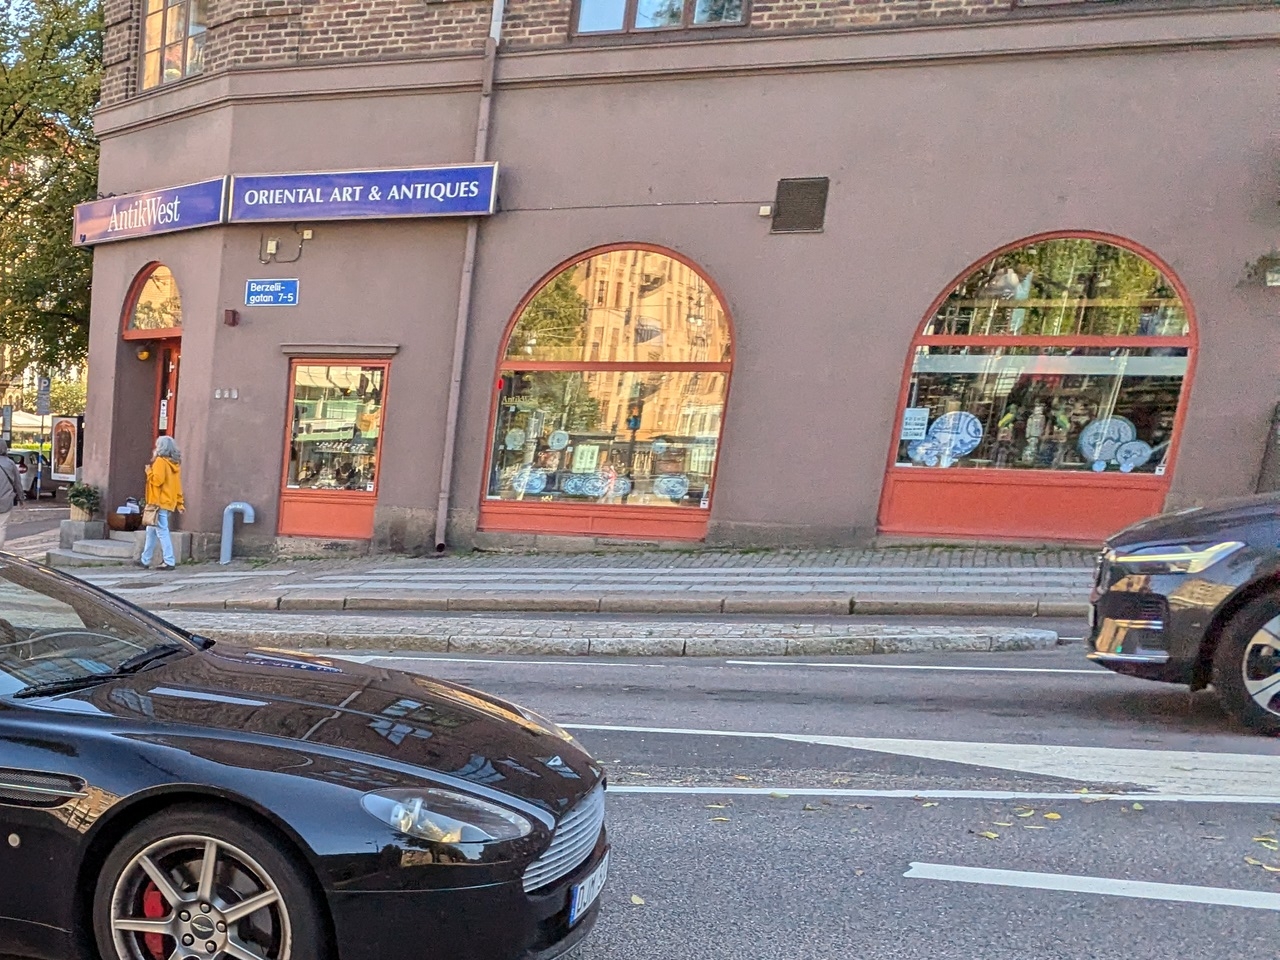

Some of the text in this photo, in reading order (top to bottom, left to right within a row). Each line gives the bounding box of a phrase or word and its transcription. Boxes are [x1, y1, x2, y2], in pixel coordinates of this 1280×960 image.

[244, 181, 479, 206] ORIENTAL ART & ANTIQUES
[107, 195, 181, 232] AntikWest
[250, 282, 286, 292] Berzelii-
[249, 292, 294, 305] gatan 7-5
[41, 379, 49, 391] P
